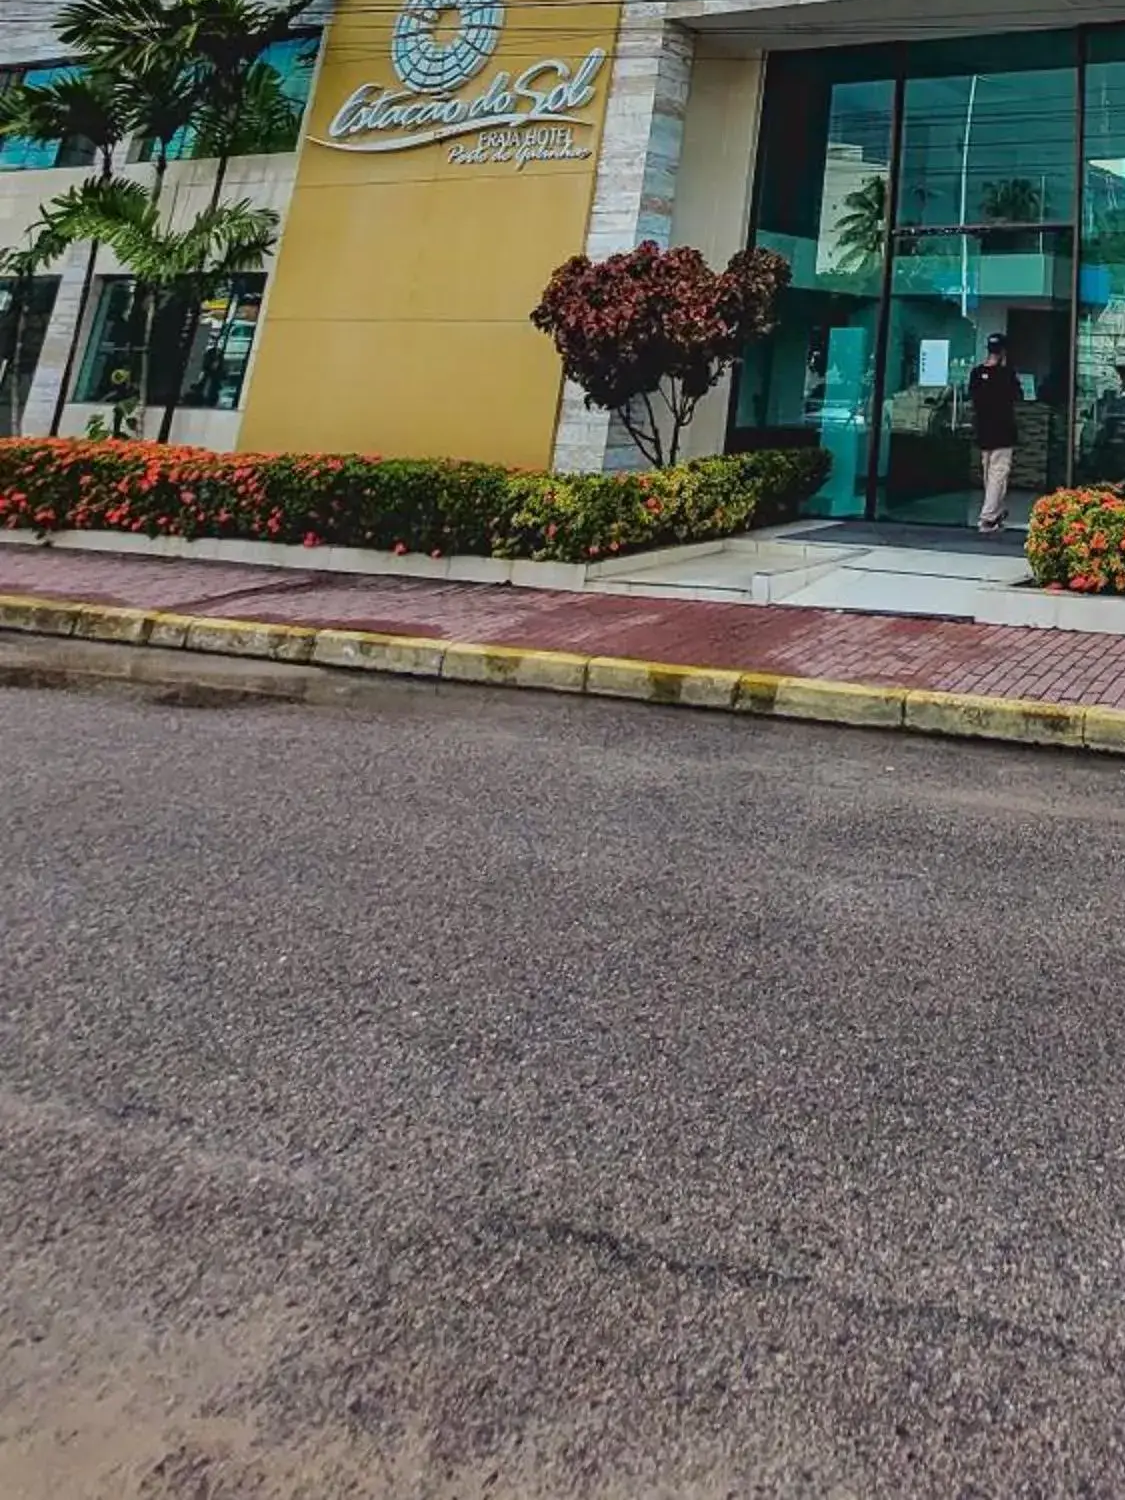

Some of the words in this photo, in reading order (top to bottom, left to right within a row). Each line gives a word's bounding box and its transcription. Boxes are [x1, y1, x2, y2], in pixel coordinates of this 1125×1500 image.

[469, 71, 515, 117] do
[514, 48, 606, 118] Sol
[478, 130, 520, 149] PRAIA
[525, 127, 574, 147] HOTEL
